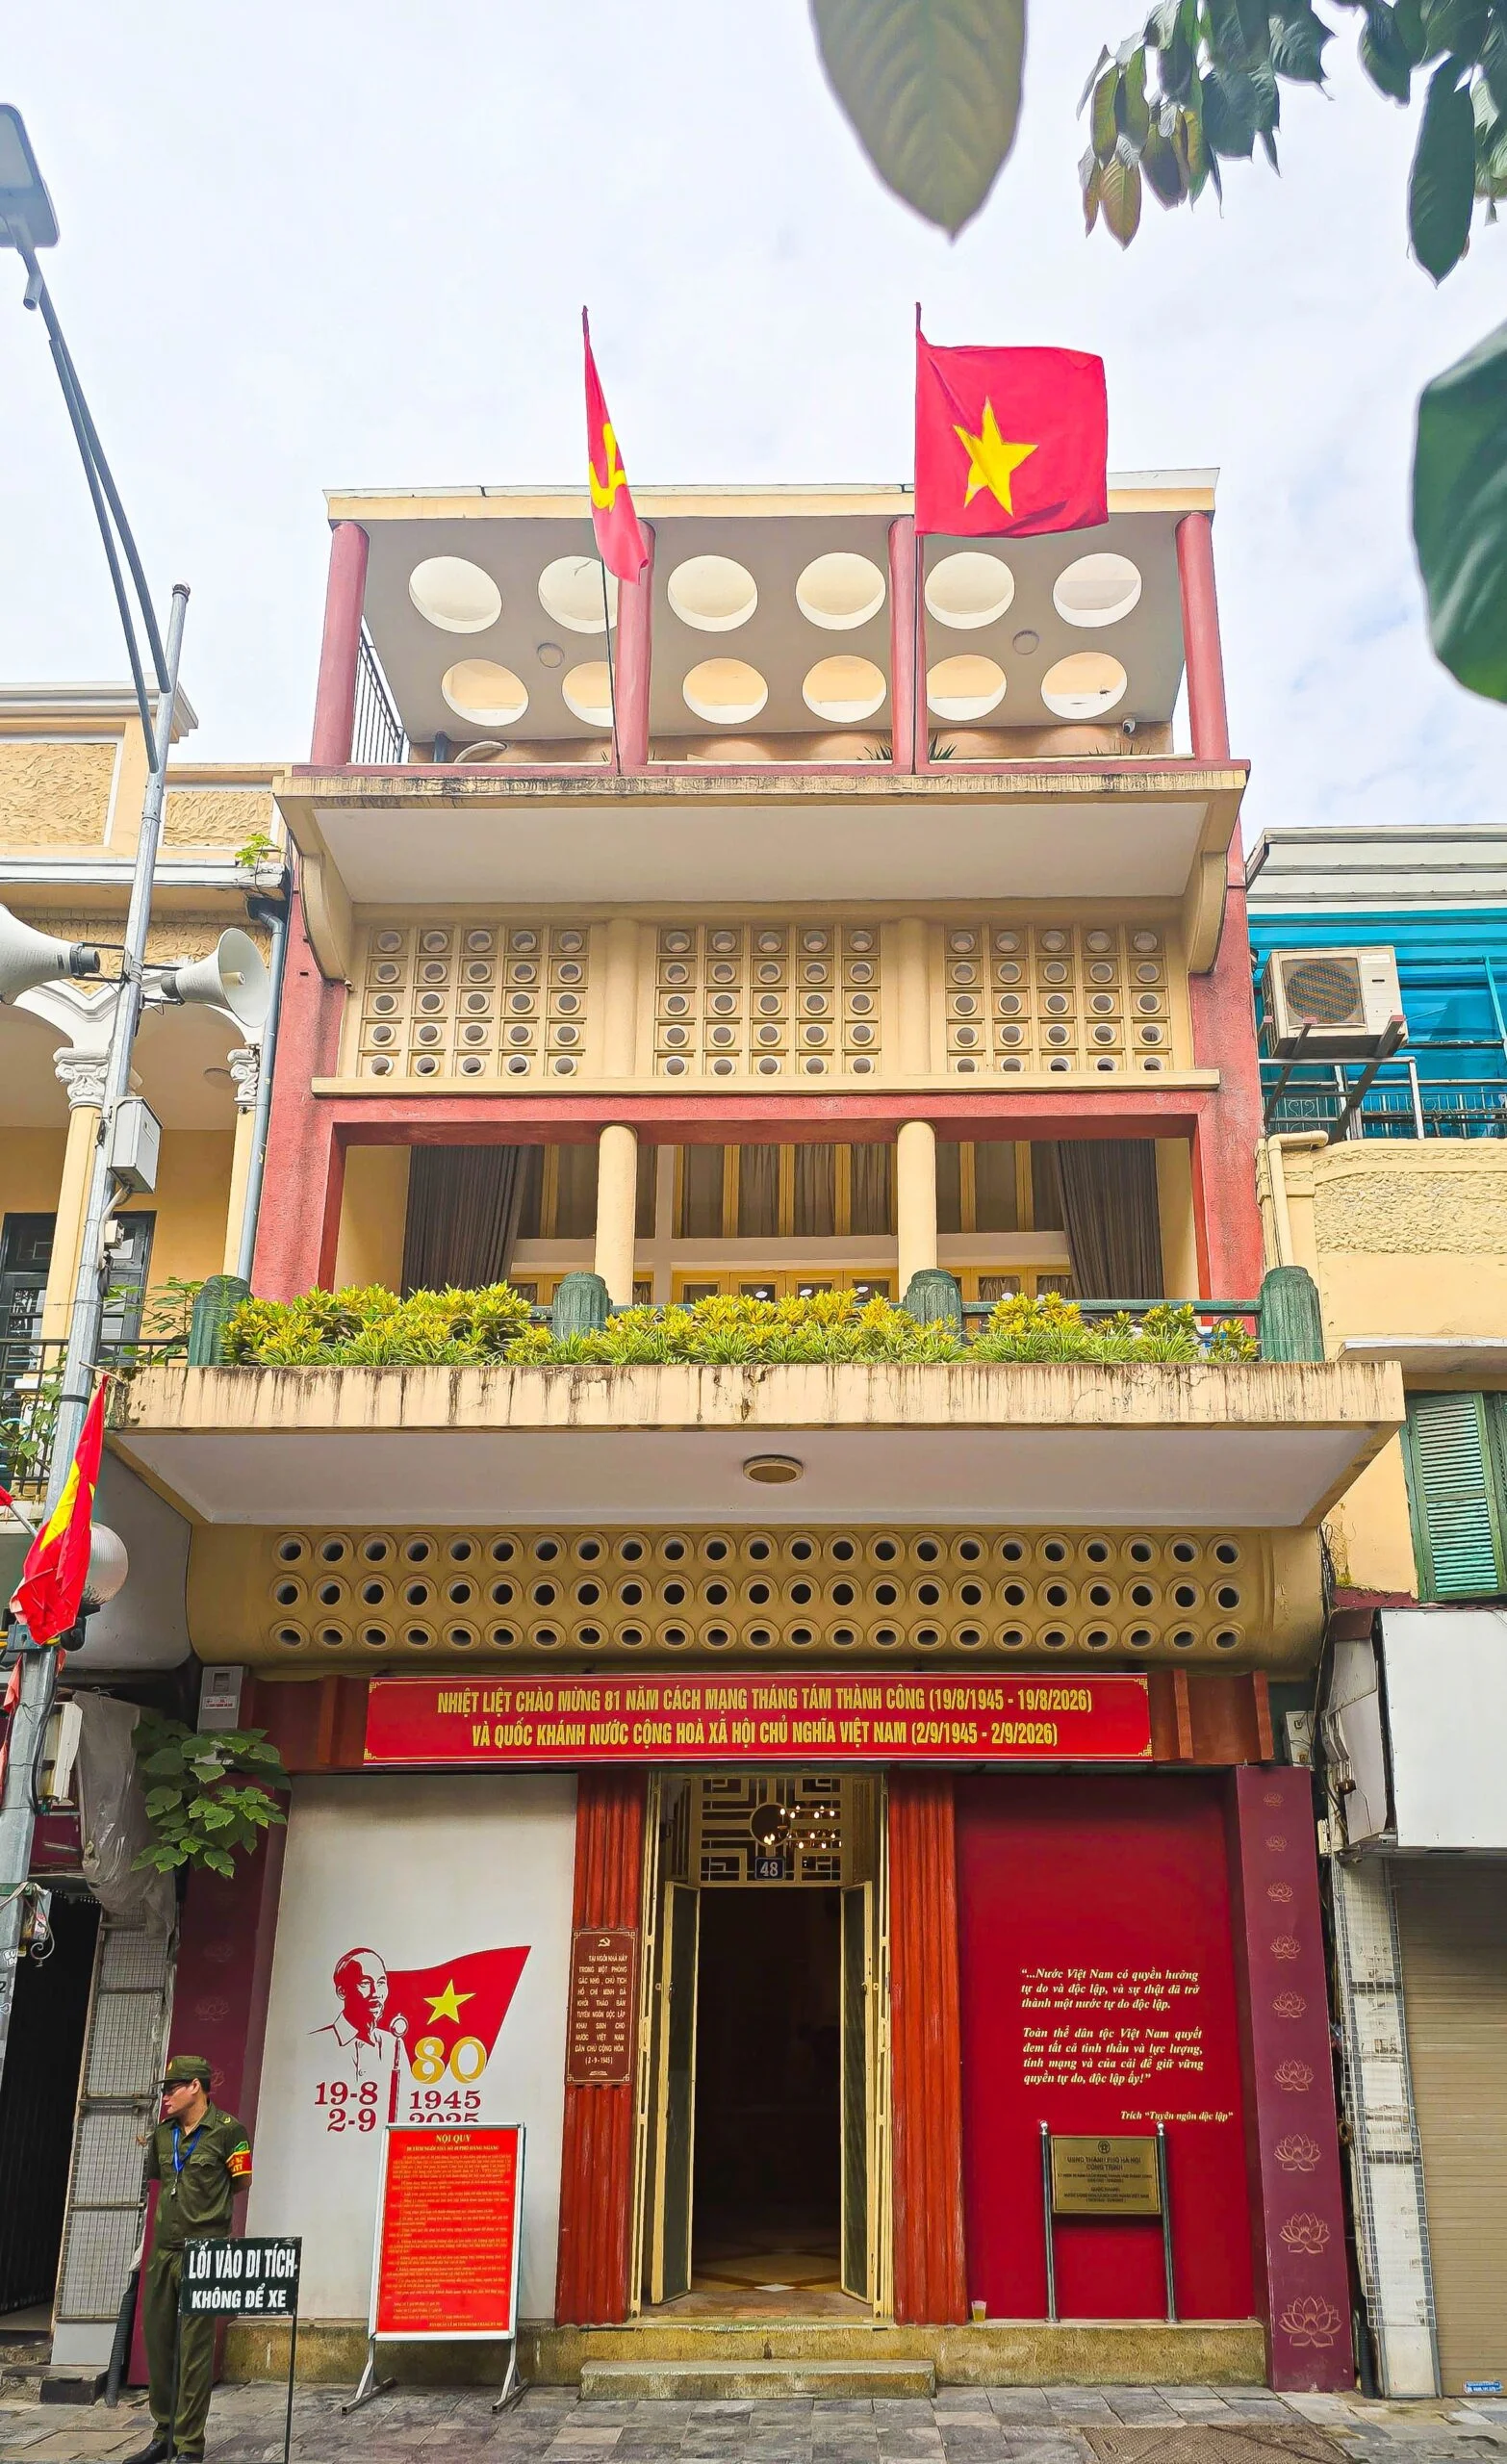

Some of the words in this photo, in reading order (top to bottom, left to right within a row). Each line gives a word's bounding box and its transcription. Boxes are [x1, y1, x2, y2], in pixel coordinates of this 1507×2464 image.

[438, 1688, 479, 1717] NHIỆT
[483, 1687, 512, 1716] LIỆT
[516, 1686, 553, 1711] CHÀO
[558, 1686, 600, 1711] MỪNG
[605, 1691, 620, 1710] 81
[626, 1685, 658, 1710] NĂM
[663, 1685, 701, 1709] CÁCH
[705, 1688, 747, 1714] MẠNG
[752, 1684, 797, 1708] THÁNG
[802, 1684, 830, 1708] TÁM
[836, 1684, 881, 1708] THÀNH
[886, 1684, 925, 1708] CÔNG
[930, 1689, 1004, 1711] (19/8/1945
[1018, 1689, 1091, 1712] 19/8/2026)
[473, 1721, 490, 1746] VÀ
[495, 1717, 532, 1748] QUỐC
[537, 1720, 585, 1745] KHÁNH
[590, 1719, 628, 1744] NƯỚC
[633, 1719, 672, 1748] CỘNG
[677, 1718, 704, 1743] HOÀ
[709, 1718, 728, 1743] XÃ
[732, 1718, 755, 1748] HỘI
[760, 1715, 787, 1743] CHỦ
[793, 1718, 835, 1742] NGHĨA
[840, 1717, 869, 1747] VIỆT
[874, 1722, 907, 1742] NAM
[912, 1722, 977, 1745] (2/9/1945
[991, 1723, 1057, 1746] 2/9/2026)
[760, 1861, 779, 1877] 48
[1068, 1969, 1086, 1981] Việt
[1090, 1969, 1113, 1978] Nam
[1117, 1969, 1128, 1979] có
[1132, 1967, 1162, 1981] quyền
[1022, 1985, 1033, 1994] tự
[1036, 1984, 1048, 1992] do
[1053, 1984, 1063, 1992] và
[1068, 1984, 1086, 1995] độc
[1090, 1984, 1108, 1995] lập,
[1113, 1985, 1123, 1993] và
[1128, 1987, 1140, 1995] sự
[1144, 1985, 1163, 1996] thật
[1168, 1985, 1180, 1993] đã
[1022, 1998, 1051, 2008] thành
[1055, 1998, 1073, 2010] một
[1076, 1998, 1101, 2008] nước
[1104, 2001, 1115, 2010] tự
[1117, 1999, 1129, 2008] do
[1133, 1999, 1149, 2011] độc
[1153, 1999, 1170, 2011] lập.
[1024, 2028, 1047, 2037] Toàn
[1054, 2025, 1069, 2038] thể
[1075, 2028, 1093, 2038] dân
[1099, 2028, 1114, 2040] tộc
[1119, 2028, 1139, 2041] Việt
[1145, 2029, 1168, 2038] Nam
[1175, 2026, 1202, 2040] quyết
[1023, 2042, 1043, 2052] đem
[1049, 2040, 1061, 2052] tất
[1107, 2040, 1129, 2053] thần
[1134, 2043, 1144, 2053] và
[1149, 2044, 1165, 2057] lực
[1170, 2043, 1202, 2056] lượng,
[411, 2036, 488, 2085] 80
[1024, 2058, 1043, 2066] tính
[1049, 2061, 1077, 2069] mạng
[1082, 2058, 1092, 2067] và
[1098, 2059, 1115, 2067] của
[1121, 2059, 1136, 2067] cải
[1156, 2059, 1174, 2070] giữ
[1179, 2060, 1204, 2070] vững
[1024, 2070, 1054, 2085] quyền
[1058, 2075, 1068, 2085] tự
[1071, 2073, 1086, 2084] do,
[1089, 2073, 1107, 2085] độc
[1110, 2073, 1125, 2086] lập
[314, 2081, 378, 2106] 19-8
[409, 2090, 481, 2110] 1945
[327, 2108, 376, 2133] 2-9
[1121, 2111, 1141, 2119] Trích
[189, 2241, 213, 2279] LỐI
[216, 2244, 243, 2279] VÀO
[245, 2249, 261, 2278] DI
[265, 2244, 295, 2278] TÍCH
[192, 2286, 242, 2309] KHÔNG
[245, 2283, 266, 2308] ĐỂ
[268, 2290, 287, 2308] XE
